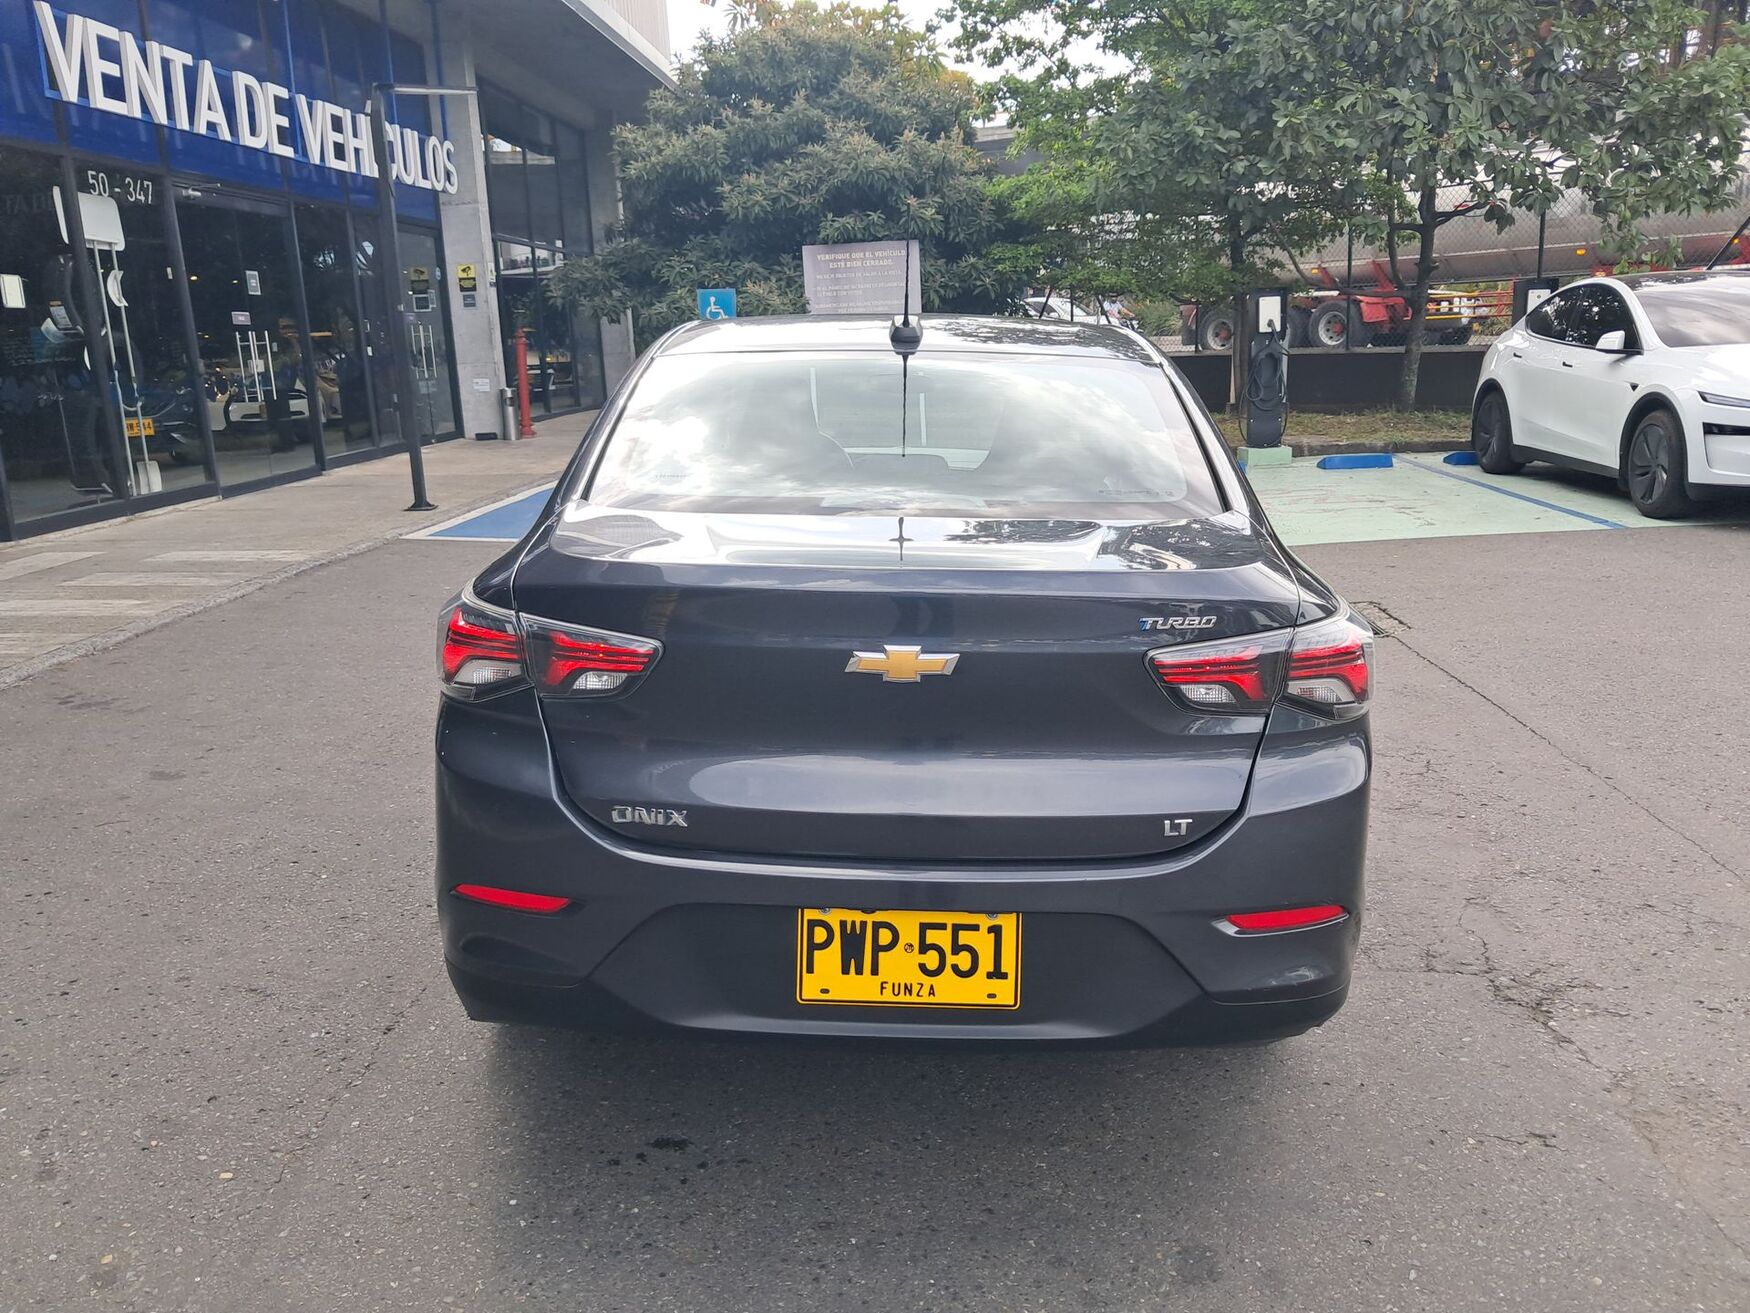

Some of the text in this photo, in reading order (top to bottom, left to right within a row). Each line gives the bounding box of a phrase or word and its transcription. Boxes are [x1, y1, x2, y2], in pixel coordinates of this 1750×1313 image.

[33, 0, 232, 142] VENTA
[232, 70, 294, 158] DE
[88, 170, 109, 197] 50
[125, 177, 152, 204] 347
[816, 252, 850, 261] VERIFIQUE
[851, 251, 864, 259] QUE
[865, 250, 873, 258] EL
[1139, 615, 1218, 631] TURBO
[611, 805, 688, 828] ONIX
[1164, 818, 1193, 837] LT
[805, 918, 1009, 980] PWP 551
[879, 980, 936, 998] FUNZA
